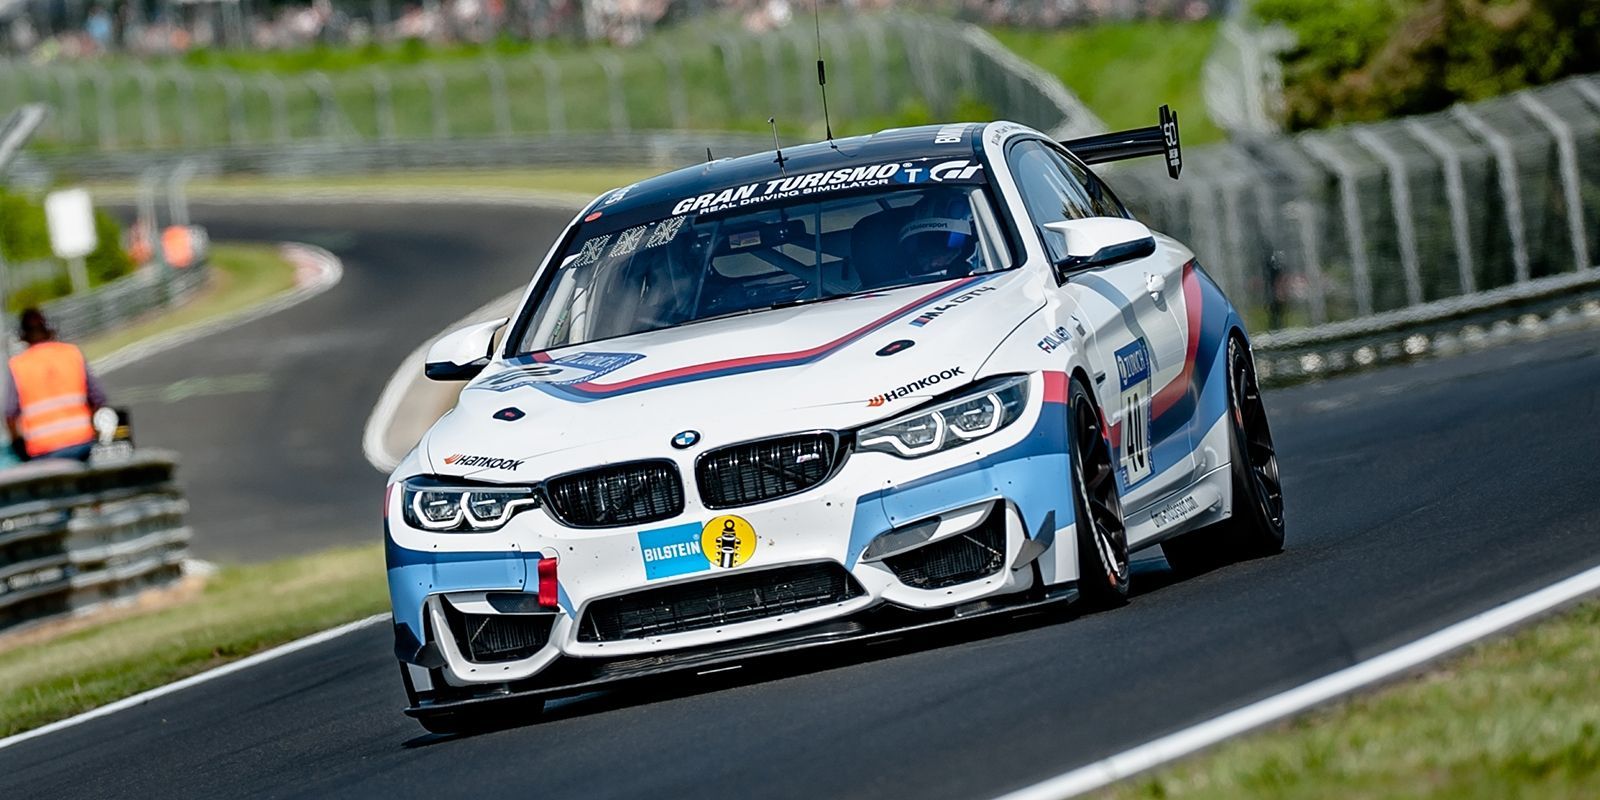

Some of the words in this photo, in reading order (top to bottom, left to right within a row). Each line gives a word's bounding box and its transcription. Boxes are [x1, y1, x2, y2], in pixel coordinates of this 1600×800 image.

[672, 182, 760, 216] GRAN
[765, 163, 900, 195] TURISMO
[699, 201, 738, 215] REAL
[740, 189, 799, 207] DRIVING
[803, 178, 889, 196] SIMULATOR
[955, 286, 996, 304] GT4
[1127, 393, 1144, 472] 40
[643, 540, 701, 562] BILSTEIN
